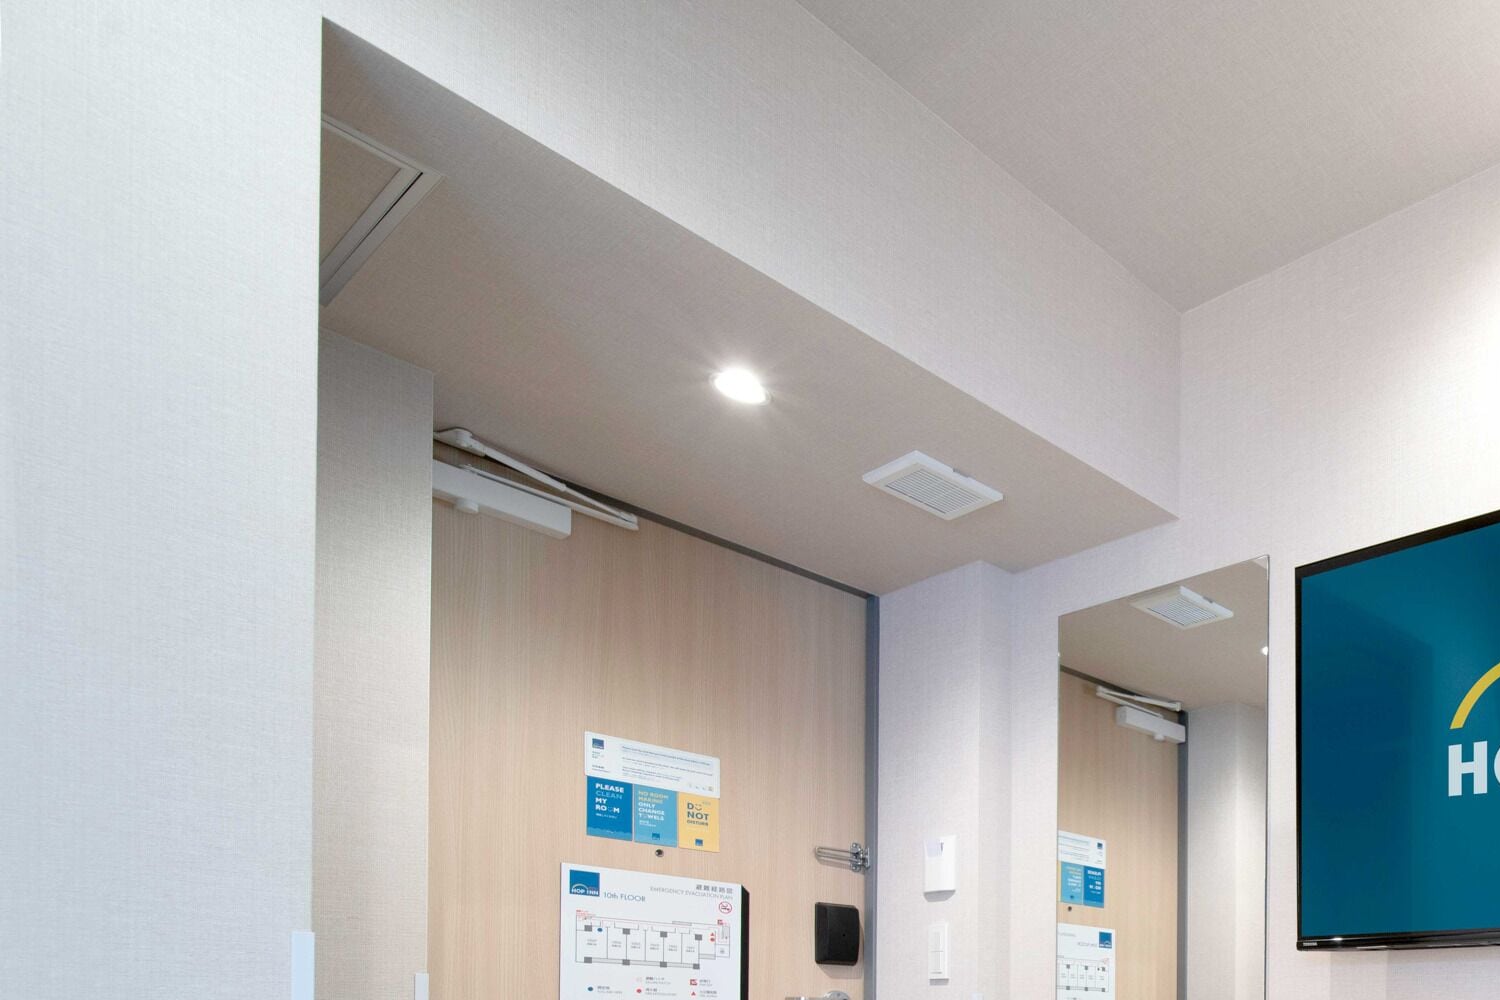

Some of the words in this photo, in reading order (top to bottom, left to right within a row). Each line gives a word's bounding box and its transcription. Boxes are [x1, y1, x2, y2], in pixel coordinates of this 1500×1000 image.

[595, 783, 624, 793] PLEASE
[595, 790, 623, 800] CLEAN
[638, 807, 665, 816] CHANGE
[687, 811, 709, 821] NOT
[649, 886, 684, 895] EMERGENCY
[685, 889, 719, 899] EVACUATION
[620, 894, 646, 902] FLOOR
